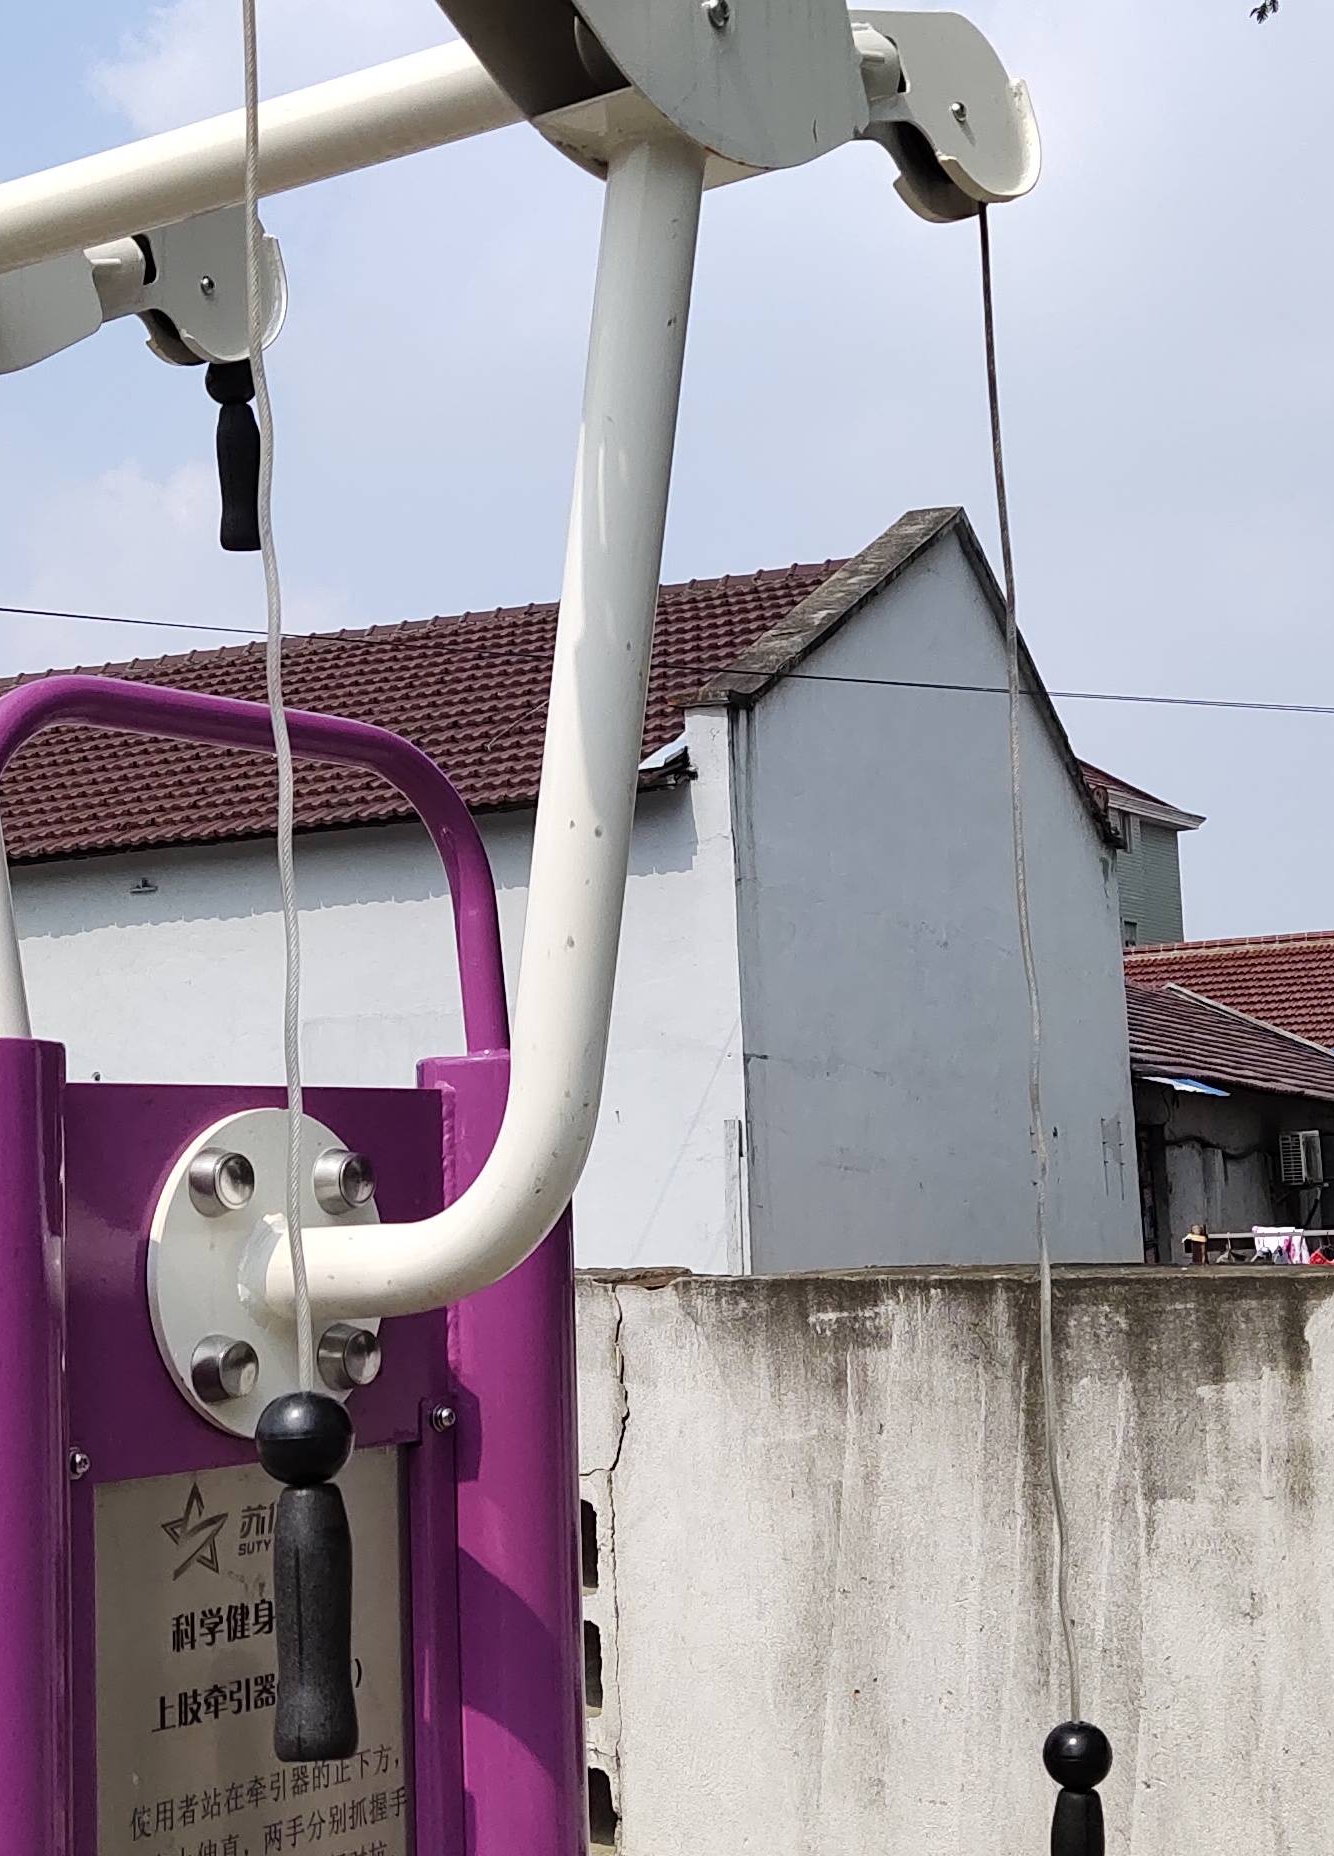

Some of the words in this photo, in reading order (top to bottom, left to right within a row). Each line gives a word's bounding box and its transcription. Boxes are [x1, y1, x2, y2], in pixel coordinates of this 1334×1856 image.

[238, 1539, 271, 1556] SUTY
[171, 1598, 275, 1653] 科学健身
[156, 1786, 407, 1856] 伸直，两手分别抓握手
